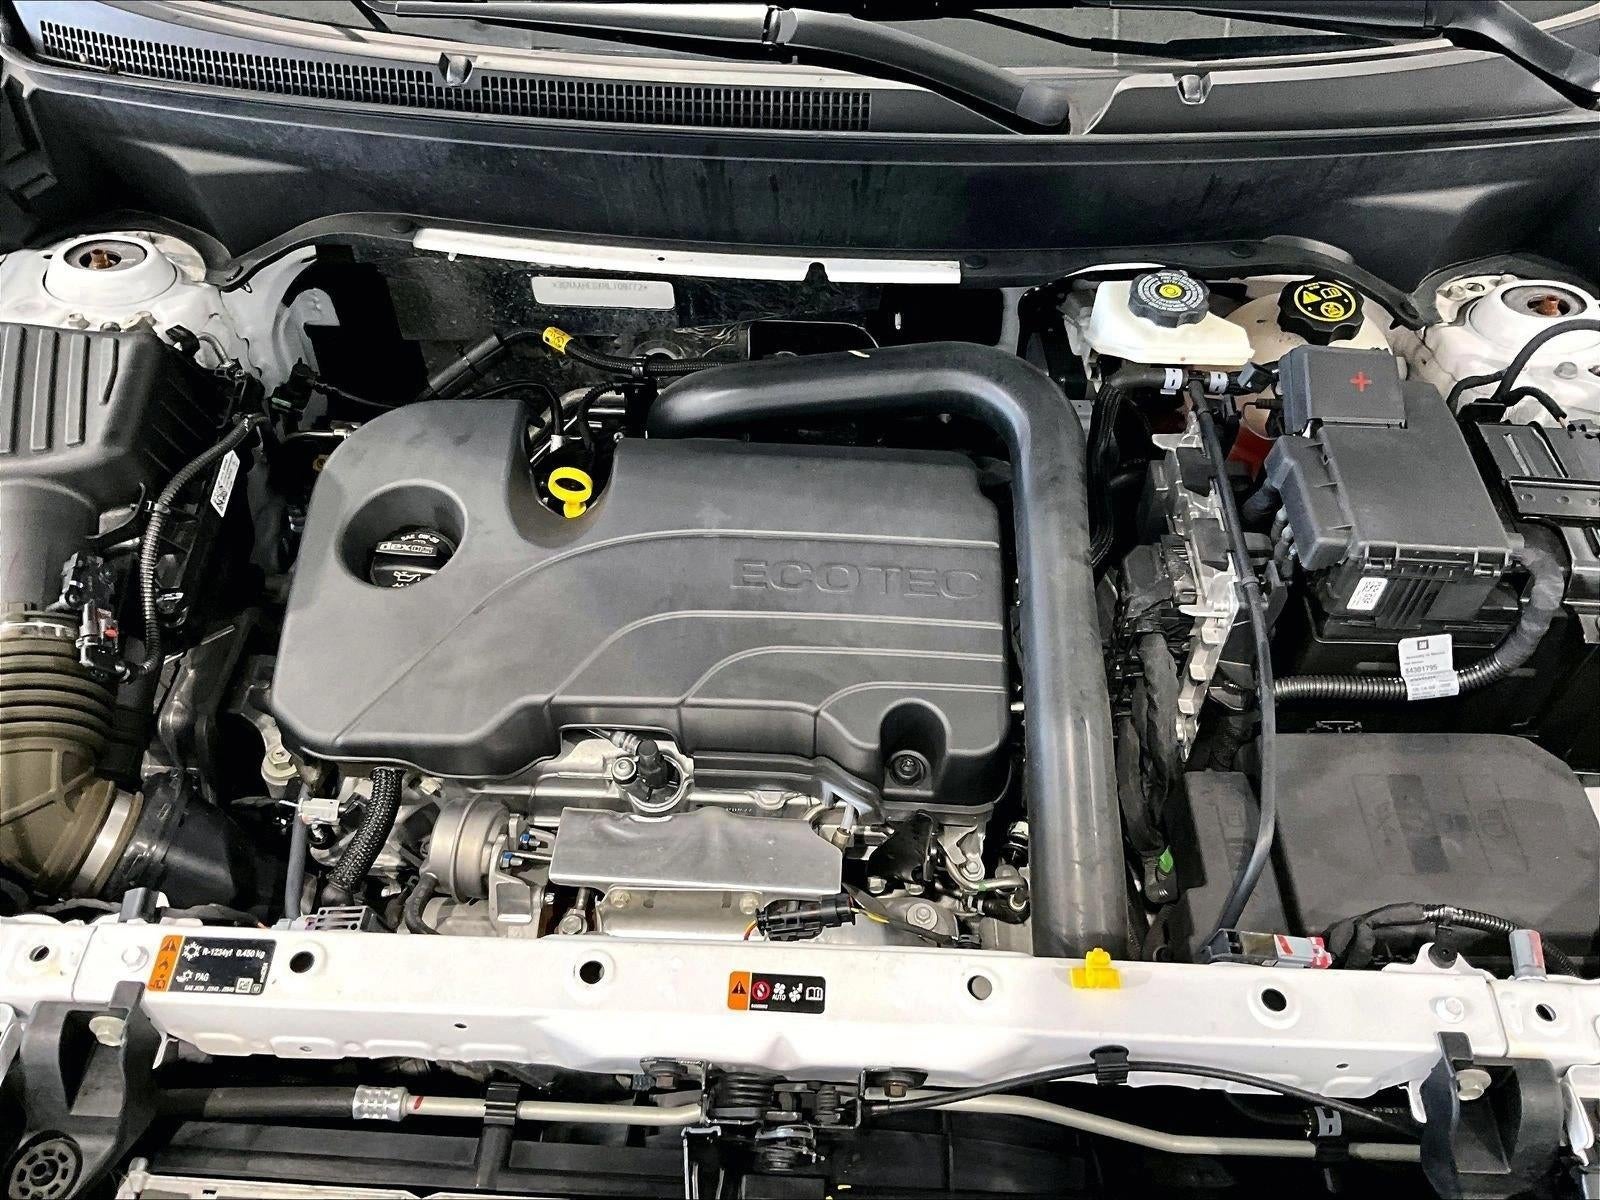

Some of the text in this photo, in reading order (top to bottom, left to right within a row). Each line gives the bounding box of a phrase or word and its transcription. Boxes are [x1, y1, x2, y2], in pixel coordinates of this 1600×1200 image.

[380, 542, 434, 554] dexos
[730, 559, 983, 600] ECOTEC
[194, 973, 210, 982] PAG
